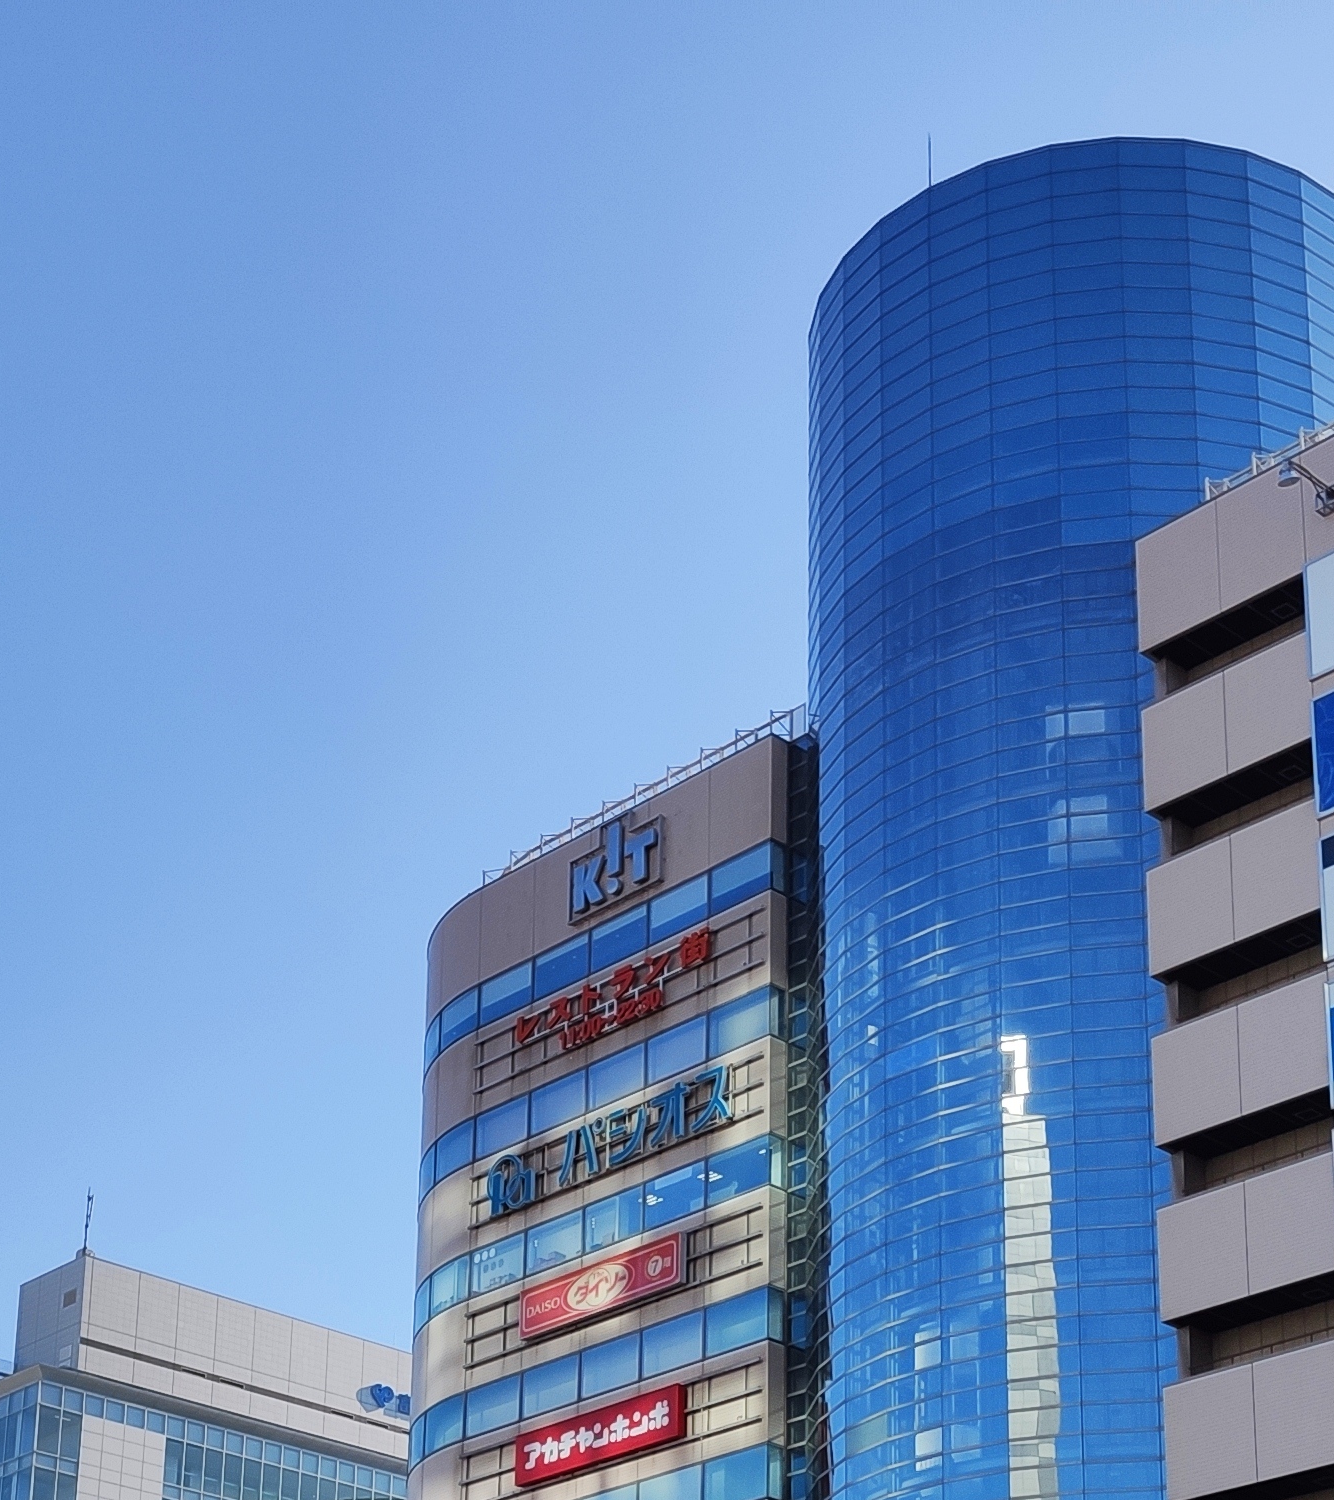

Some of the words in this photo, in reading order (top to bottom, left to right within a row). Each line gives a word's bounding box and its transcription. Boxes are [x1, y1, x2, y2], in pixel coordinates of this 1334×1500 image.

[514, 926, 711, 1044] レストラン街
[557, 1064, 734, 1188] パシオス
[527, 1296, 560, 1318] DAISO
[523, 1400, 670, 1470] アカチャンホンポ
